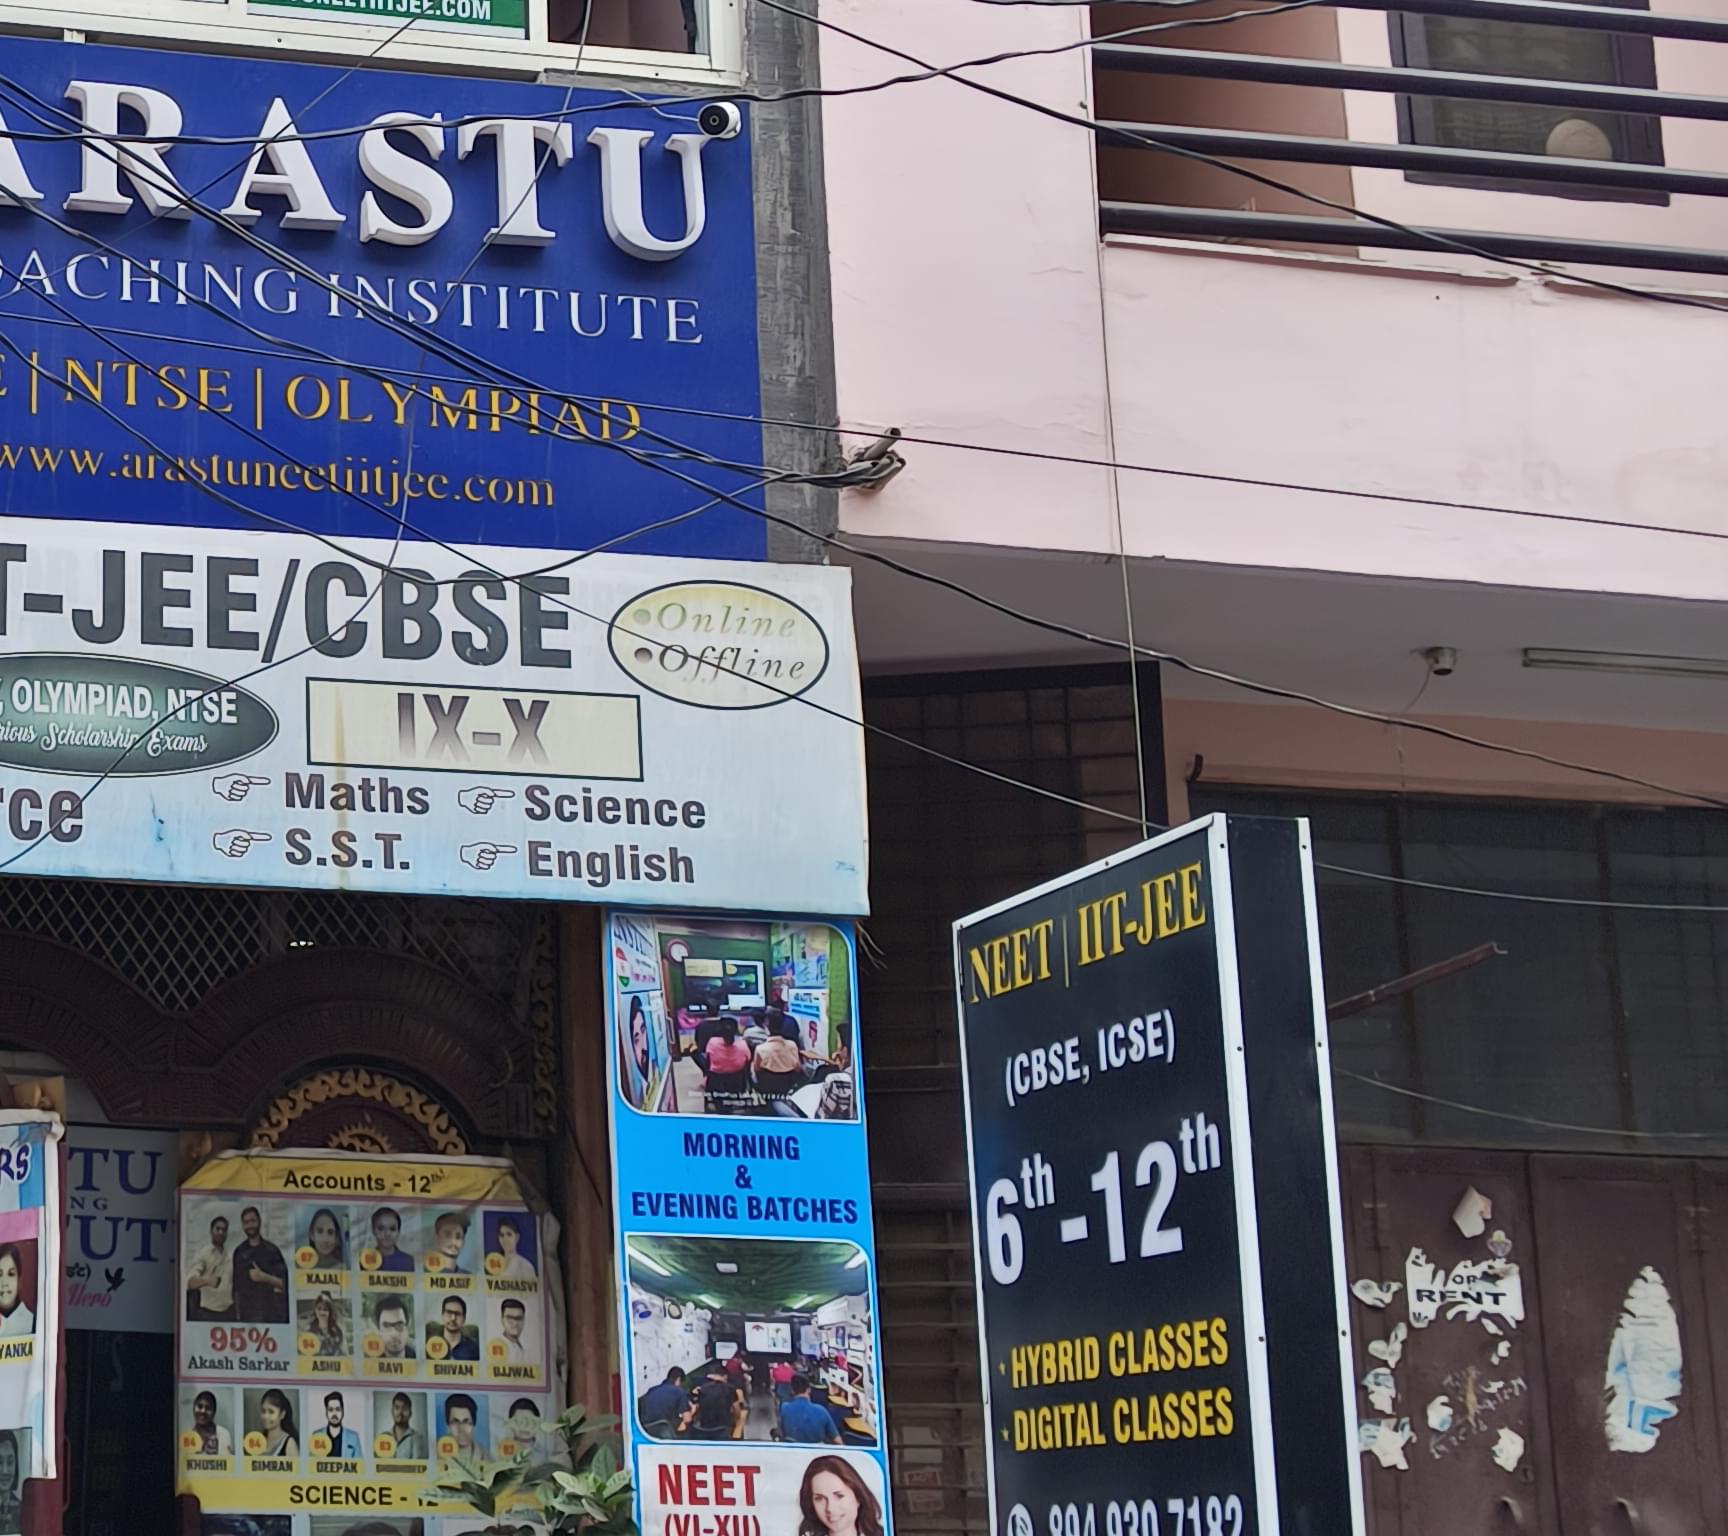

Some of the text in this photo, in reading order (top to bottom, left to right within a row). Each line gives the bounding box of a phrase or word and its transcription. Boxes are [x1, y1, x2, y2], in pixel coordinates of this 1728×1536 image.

[327, 272, 705, 346] INSTITUTE
[63, 359, 233, 414] NTSE
[284, 373, 641, 444] OLYMPIAD
[655, 600, 797, 640] Online
[658, 642, 806, 681] Offline
[11, 677, 160, 724] OLYMPIAD,
[167, 688, 238, 724] NTSE
[40, 723, 142, 757] Scholarship
[146, 729, 208, 758] Exams
[396, 692, 551, 764] IX-X
[283, 771, 706, 830] Maths Science
[283, 826, 696, 888] S.S.T. English
[968, 861, 1206, 1005] NEET IIT-JEE
[1004, 1008, 1177, 1107] (CBSE, ICSE)
[682, 1131, 801, 1161] MORNING
[67, 1146, 163, 1196] TU
[282, 1169, 386, 1192] Accounts
[734, 1164, 753, 1190] &
[632, 1191, 858, 1225] EVENING BATCHES
[1415, 1288, 1507, 1306] RENT
[210, 1326, 279, 1354] 95%
[1010, 1317, 1229, 1390] HYBRID CLASSES
[187, 1354, 290, 1373] Akash Sarkar
[1013, 1386, 1234, 1453] DIGITAL CLASSES
[288, 1484, 394, 1507] SCIENCE
[658, 1463, 762, 1507] NEET
